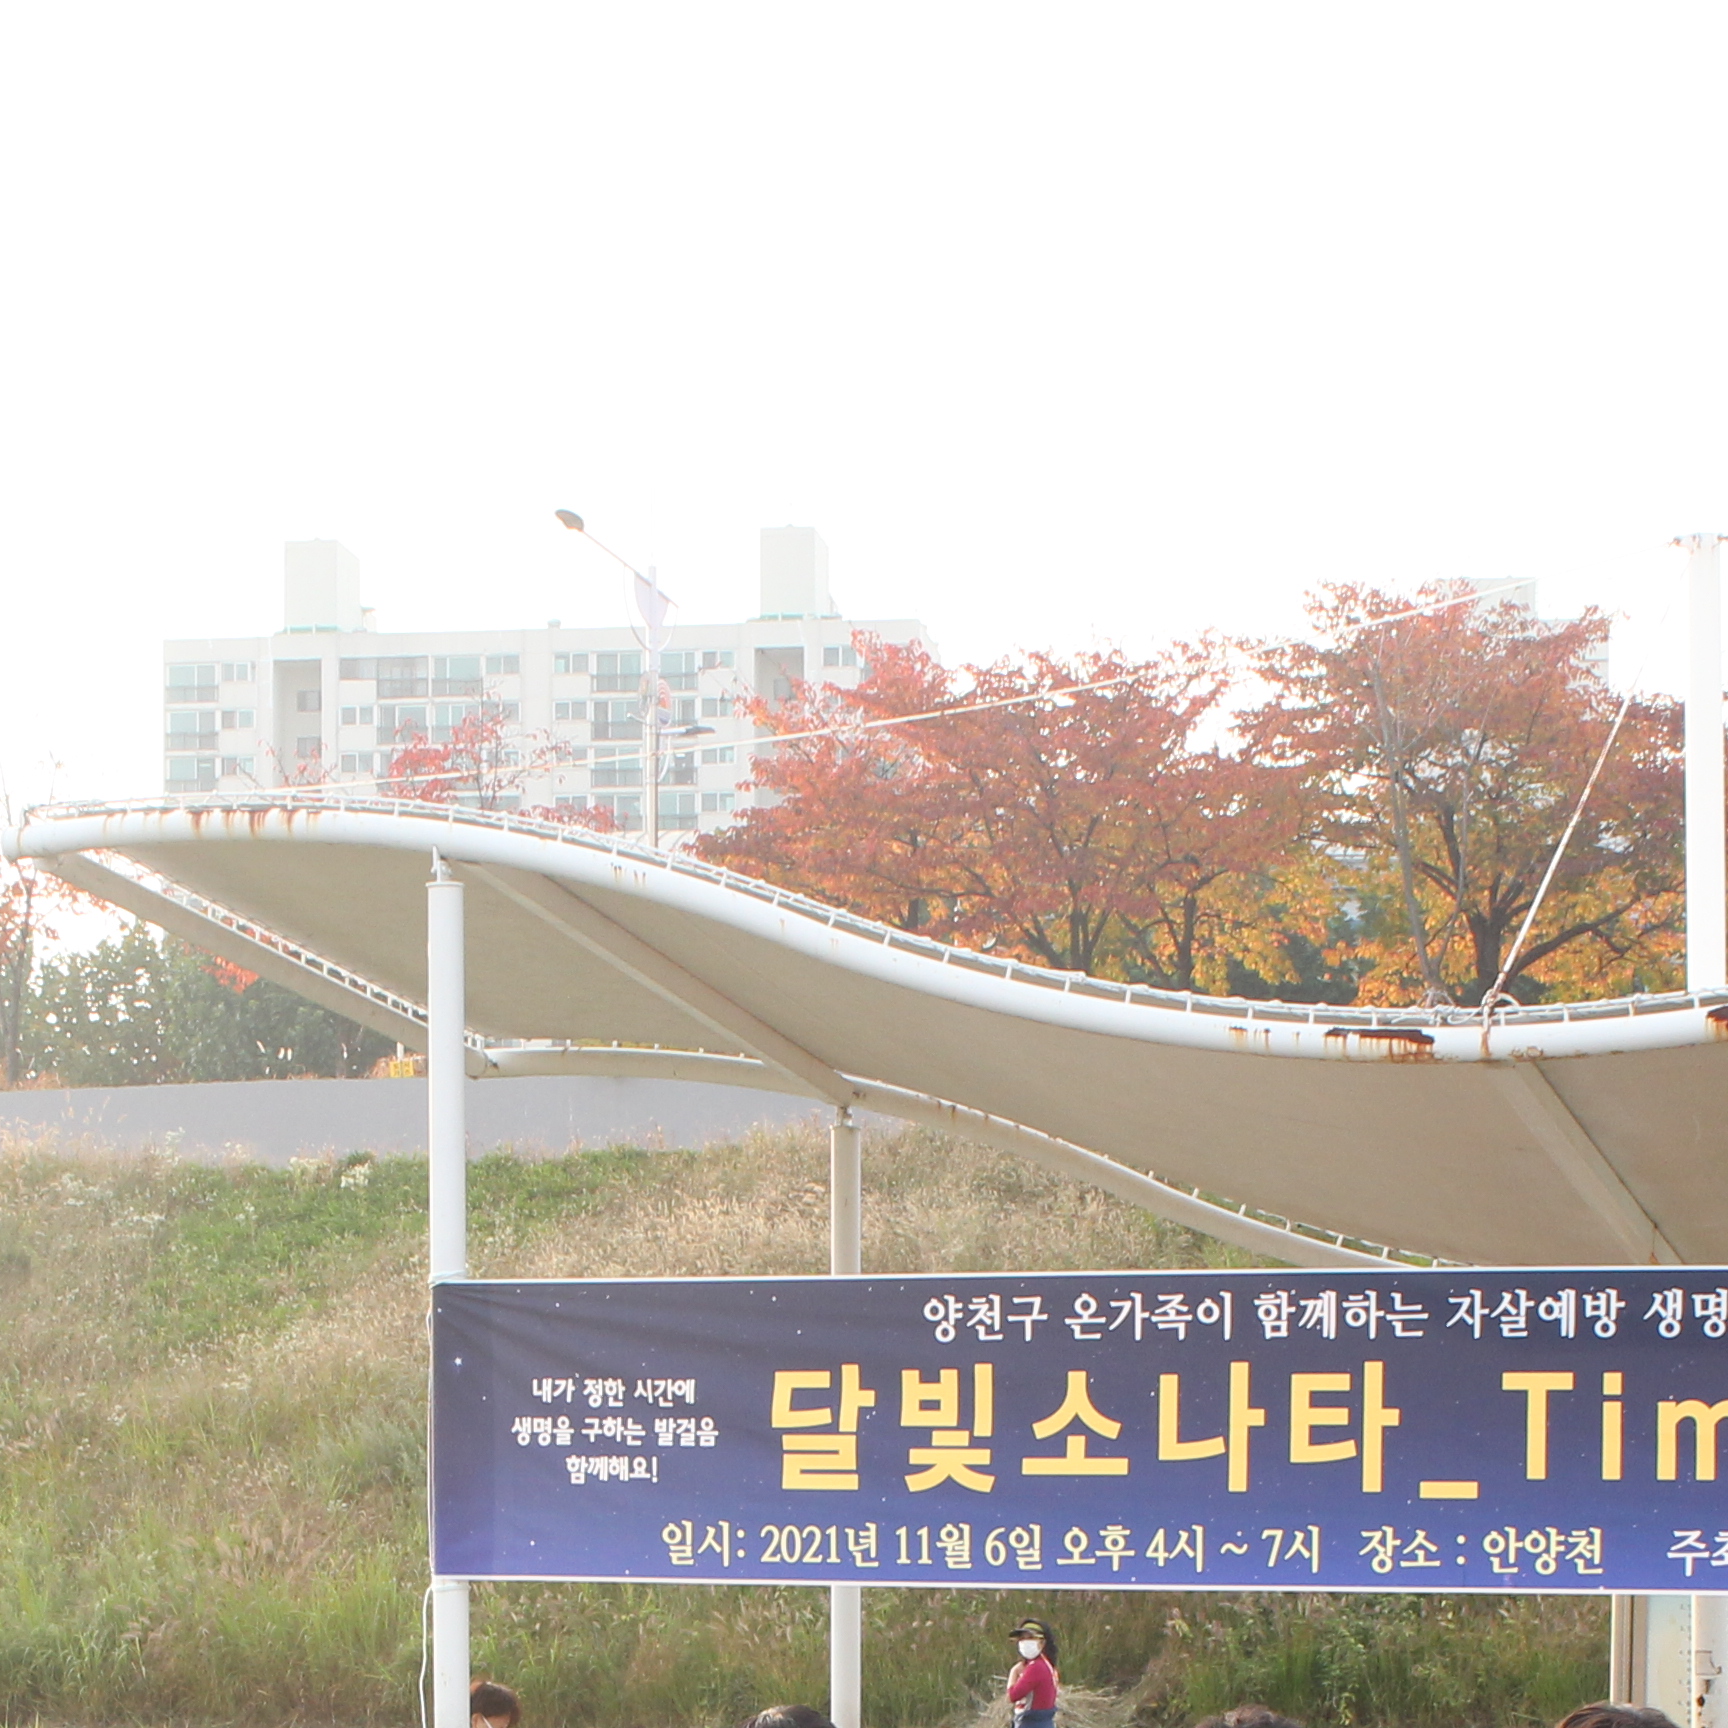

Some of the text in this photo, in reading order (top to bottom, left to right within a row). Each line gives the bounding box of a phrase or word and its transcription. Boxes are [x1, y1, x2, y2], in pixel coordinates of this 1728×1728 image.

[922, 1295, 1049, 1343] 양천구
[1063, 1291, 1234, 1341] 온가족이
[1252, 1291, 1429, 1340] 함께하는
[1446, 1288, 1625, 1341] 자살예방
[531, 1377, 696, 1408] 내가 정한 시간에
[511, 1415, 720, 1447] 생명을 구하는 발걸음
[565, 1454, 659, 1485] 함께해요!
[661, 1521, 746, 1568] 일시:
[759, 1522, 879, 1569] 2021년
[895, 1522, 973, 1570] 11월
[984, 1524, 1043, 1571] 6일
[1056, 1523, 1136, 1572] 오후
[1146, 1524, 1208, 1574] 4시
[1260, 1524, 1322, 1575] 7시
[1358, 1524, 1440, 1575] 장소
[1482, 1527, 1605, 1578] 안양천
